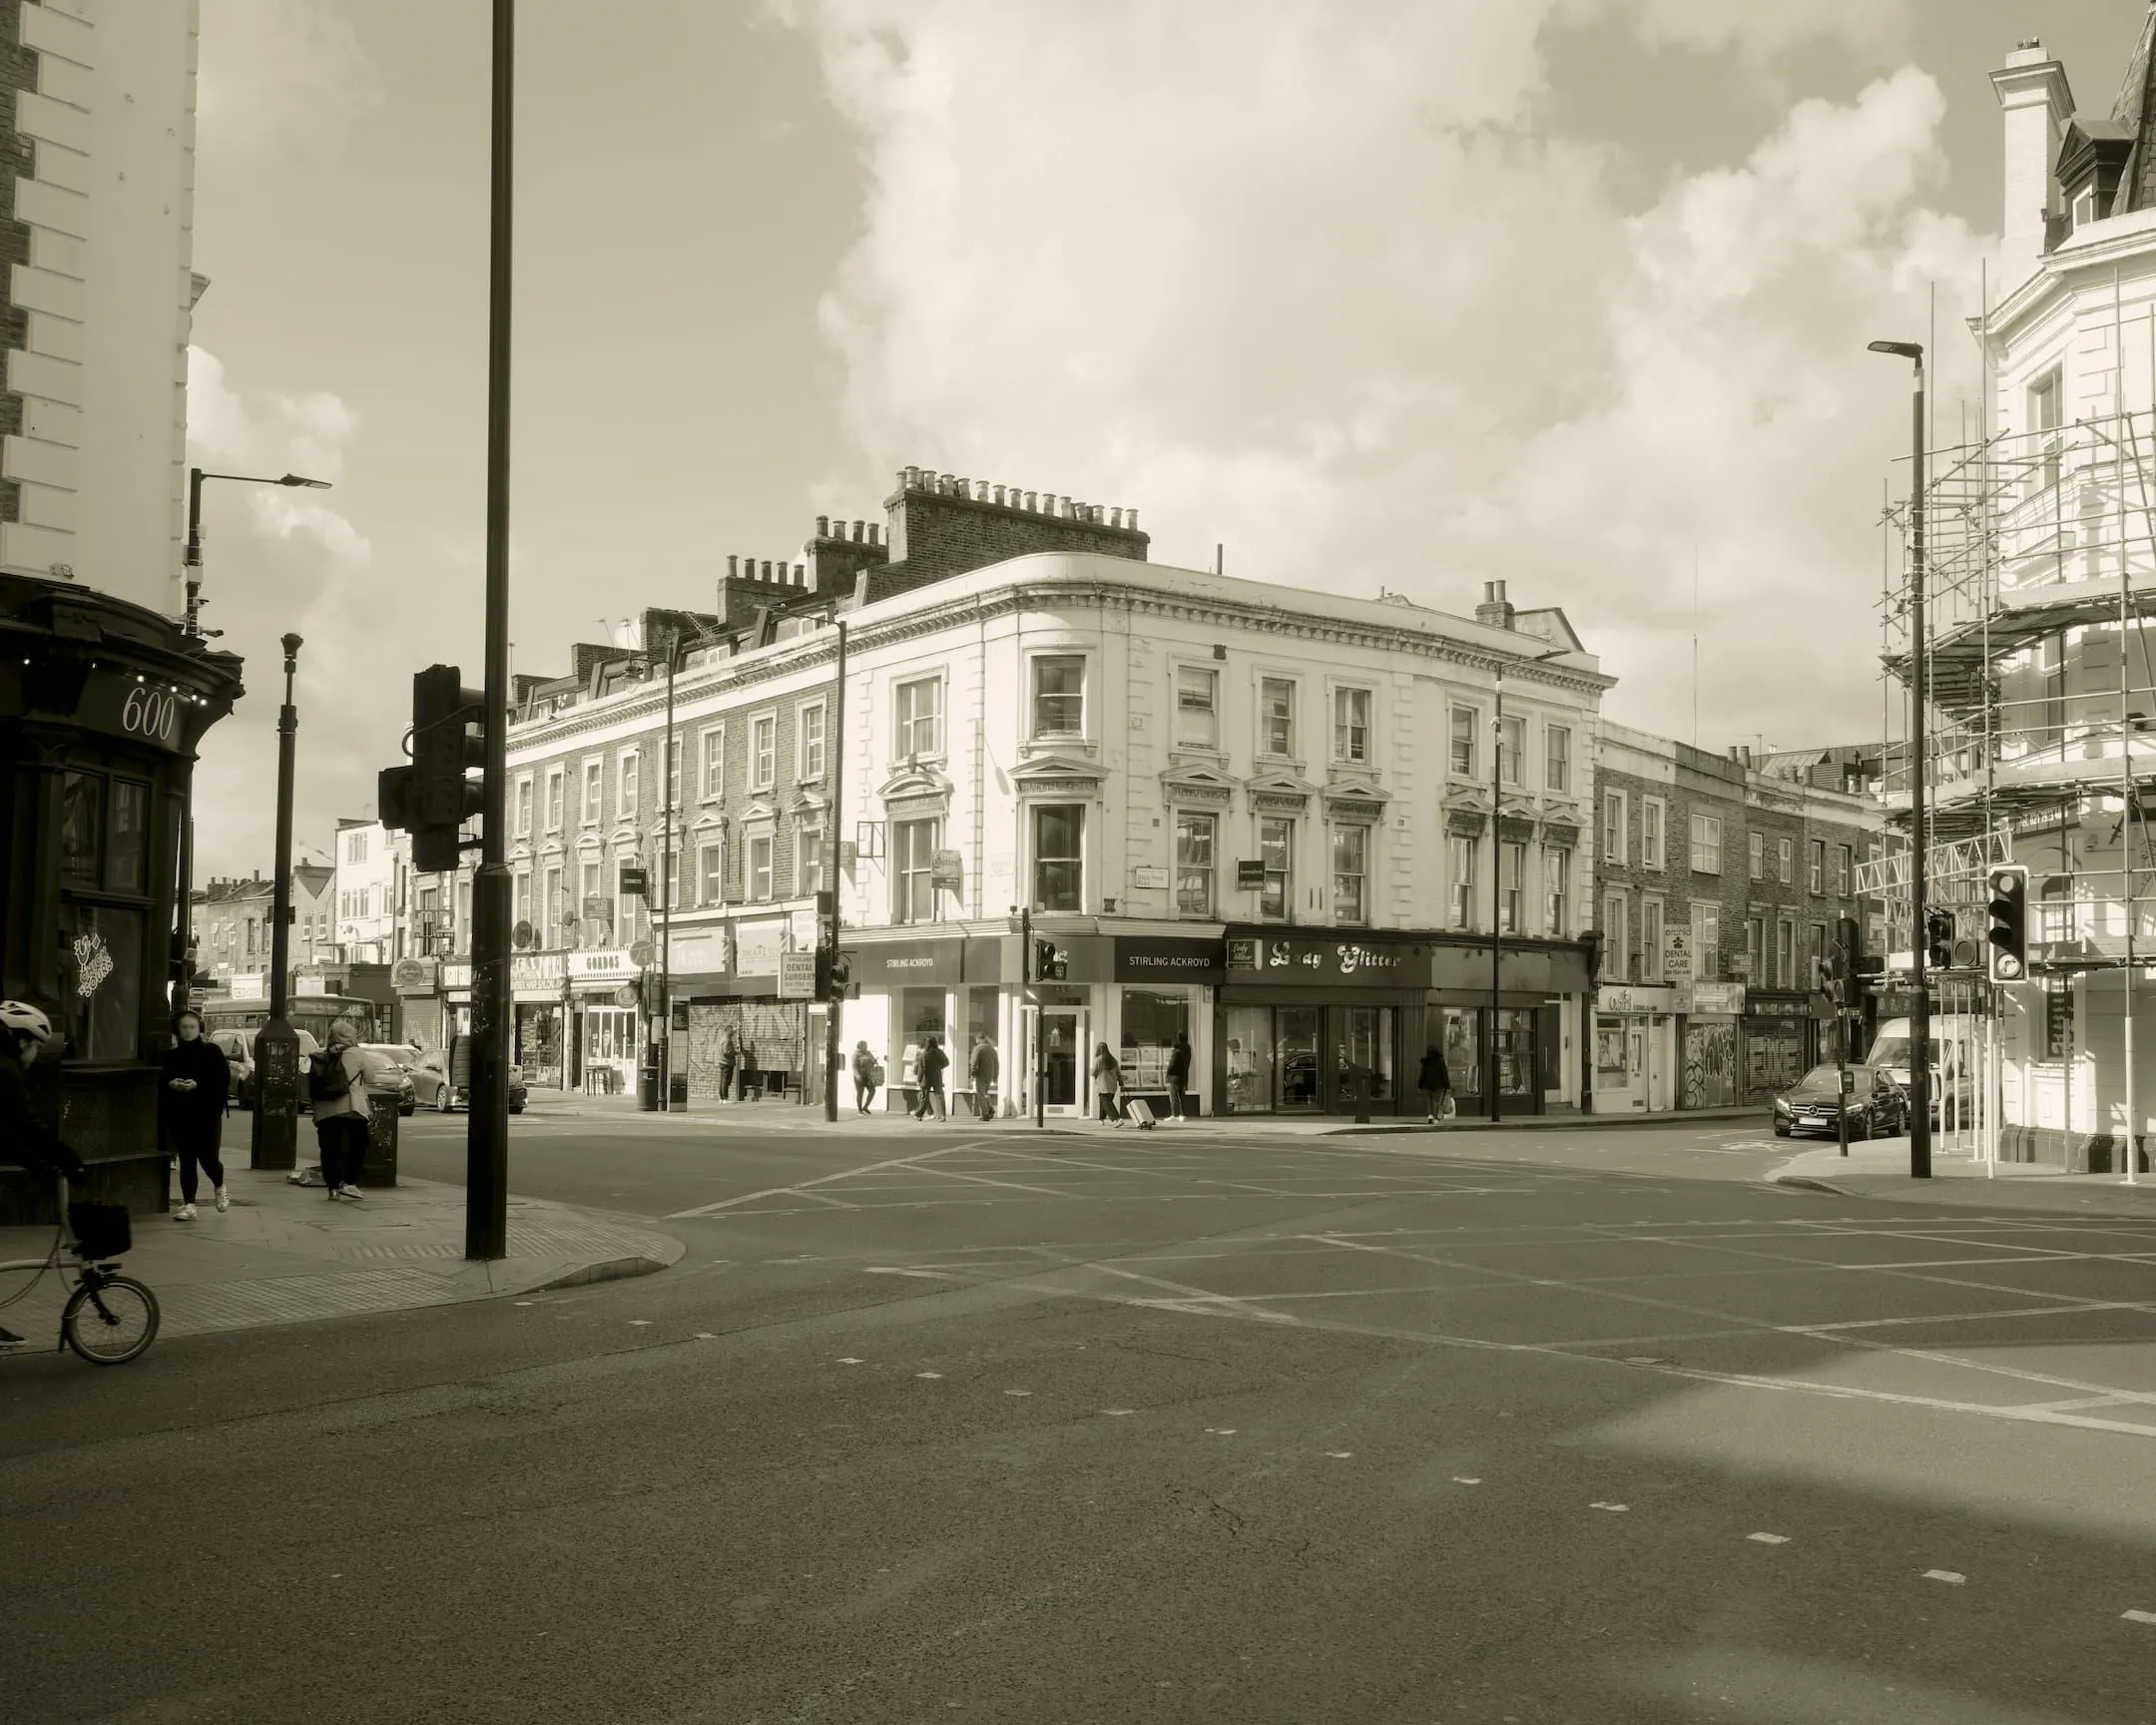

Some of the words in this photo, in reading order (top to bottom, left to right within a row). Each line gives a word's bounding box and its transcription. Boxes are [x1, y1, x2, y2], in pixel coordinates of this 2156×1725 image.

[122, 687, 175, 740] 600
[1665, 925, 1692, 936] orchid
[1269, 941, 1323, 969] Ldy
[1664, 949, 1692, 958] DENTAL
[586, 955, 620, 970] GORDOS
[886, 958, 908, 968] STIRLING
[909, 957, 933, 967] ACKROYD
[1129, 956, 1169, 966] STIRLING
[1170, 957, 1211, 967] ACKROYD
[1668, 959, 1689, 968] CARE
